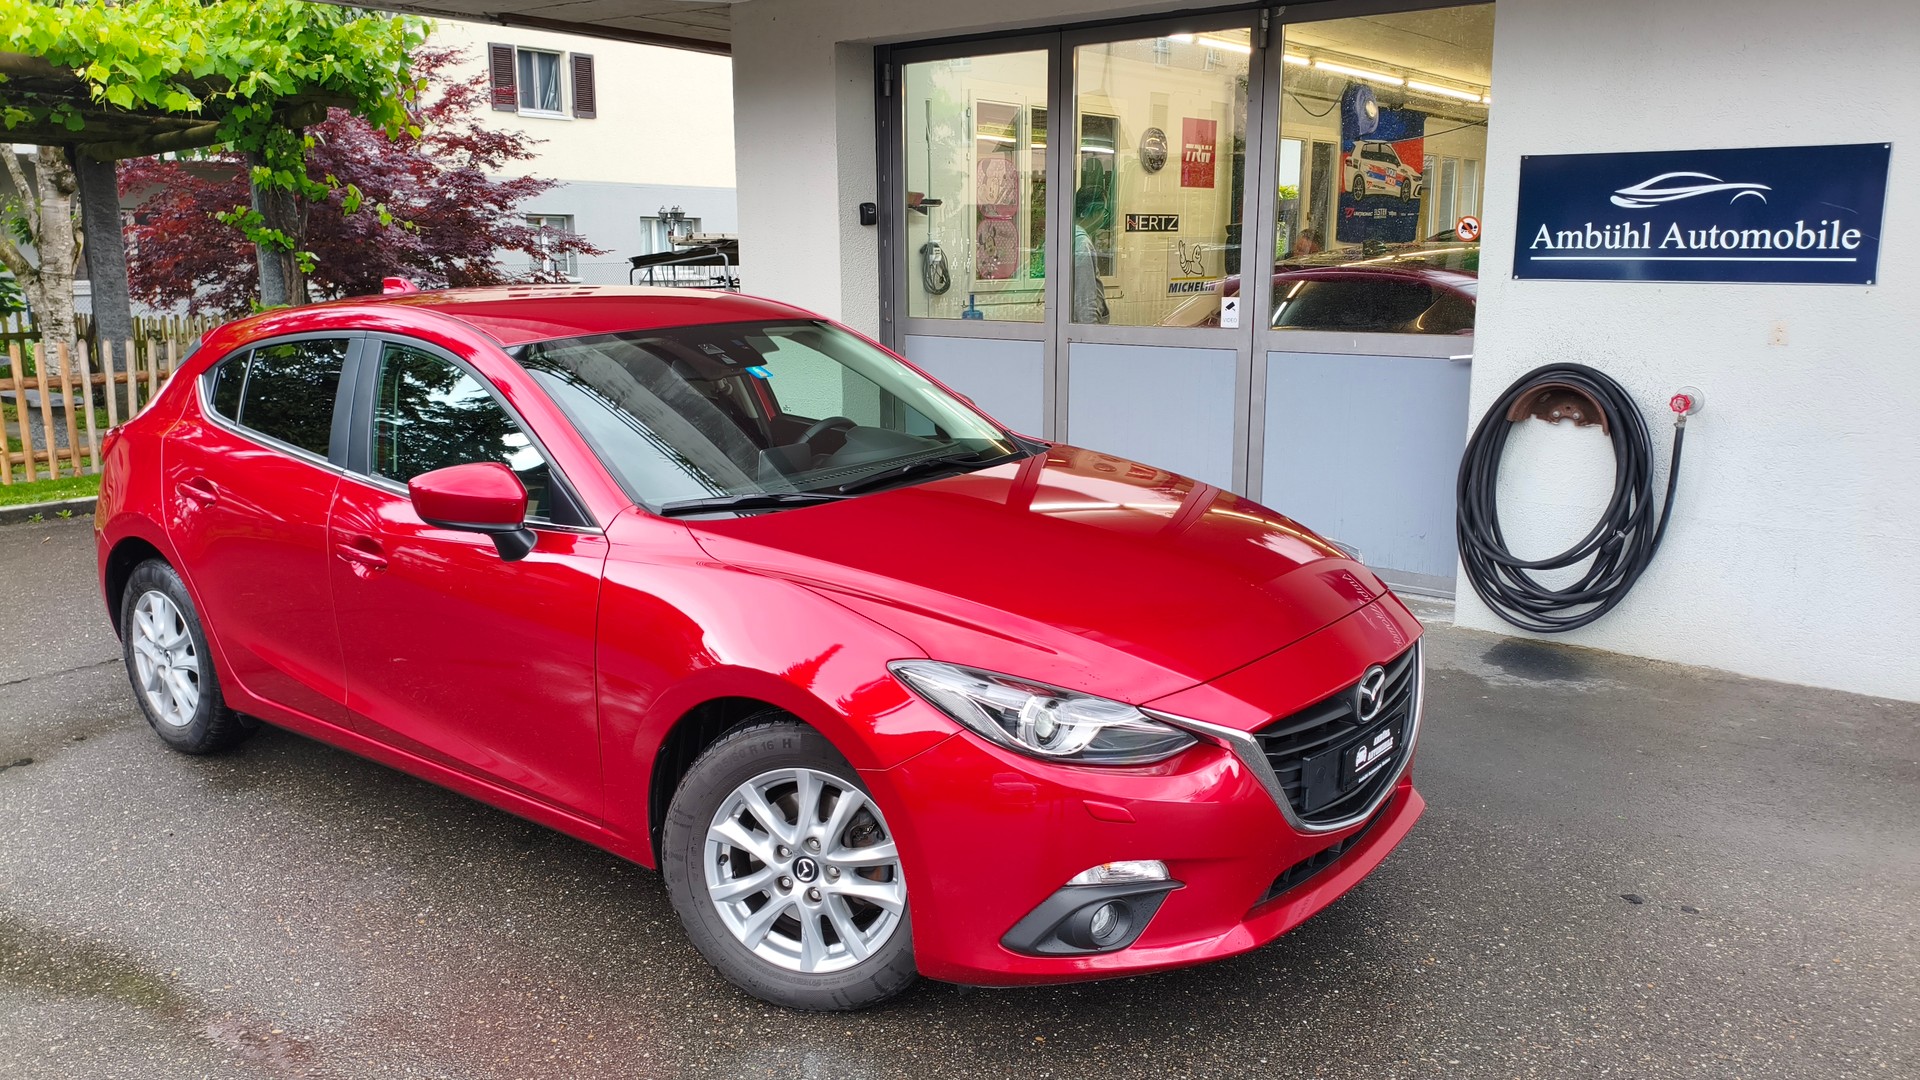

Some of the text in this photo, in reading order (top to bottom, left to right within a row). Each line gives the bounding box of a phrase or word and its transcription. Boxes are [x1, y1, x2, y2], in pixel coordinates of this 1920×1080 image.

[1185, 143, 1212, 163] TRW
[1126, 215, 1178, 230] HERTZ
[1530, 219, 1861, 251] Ambühl Automobile
[761, 740, 775, 751] 16
[782, 738, 792, 749] H
